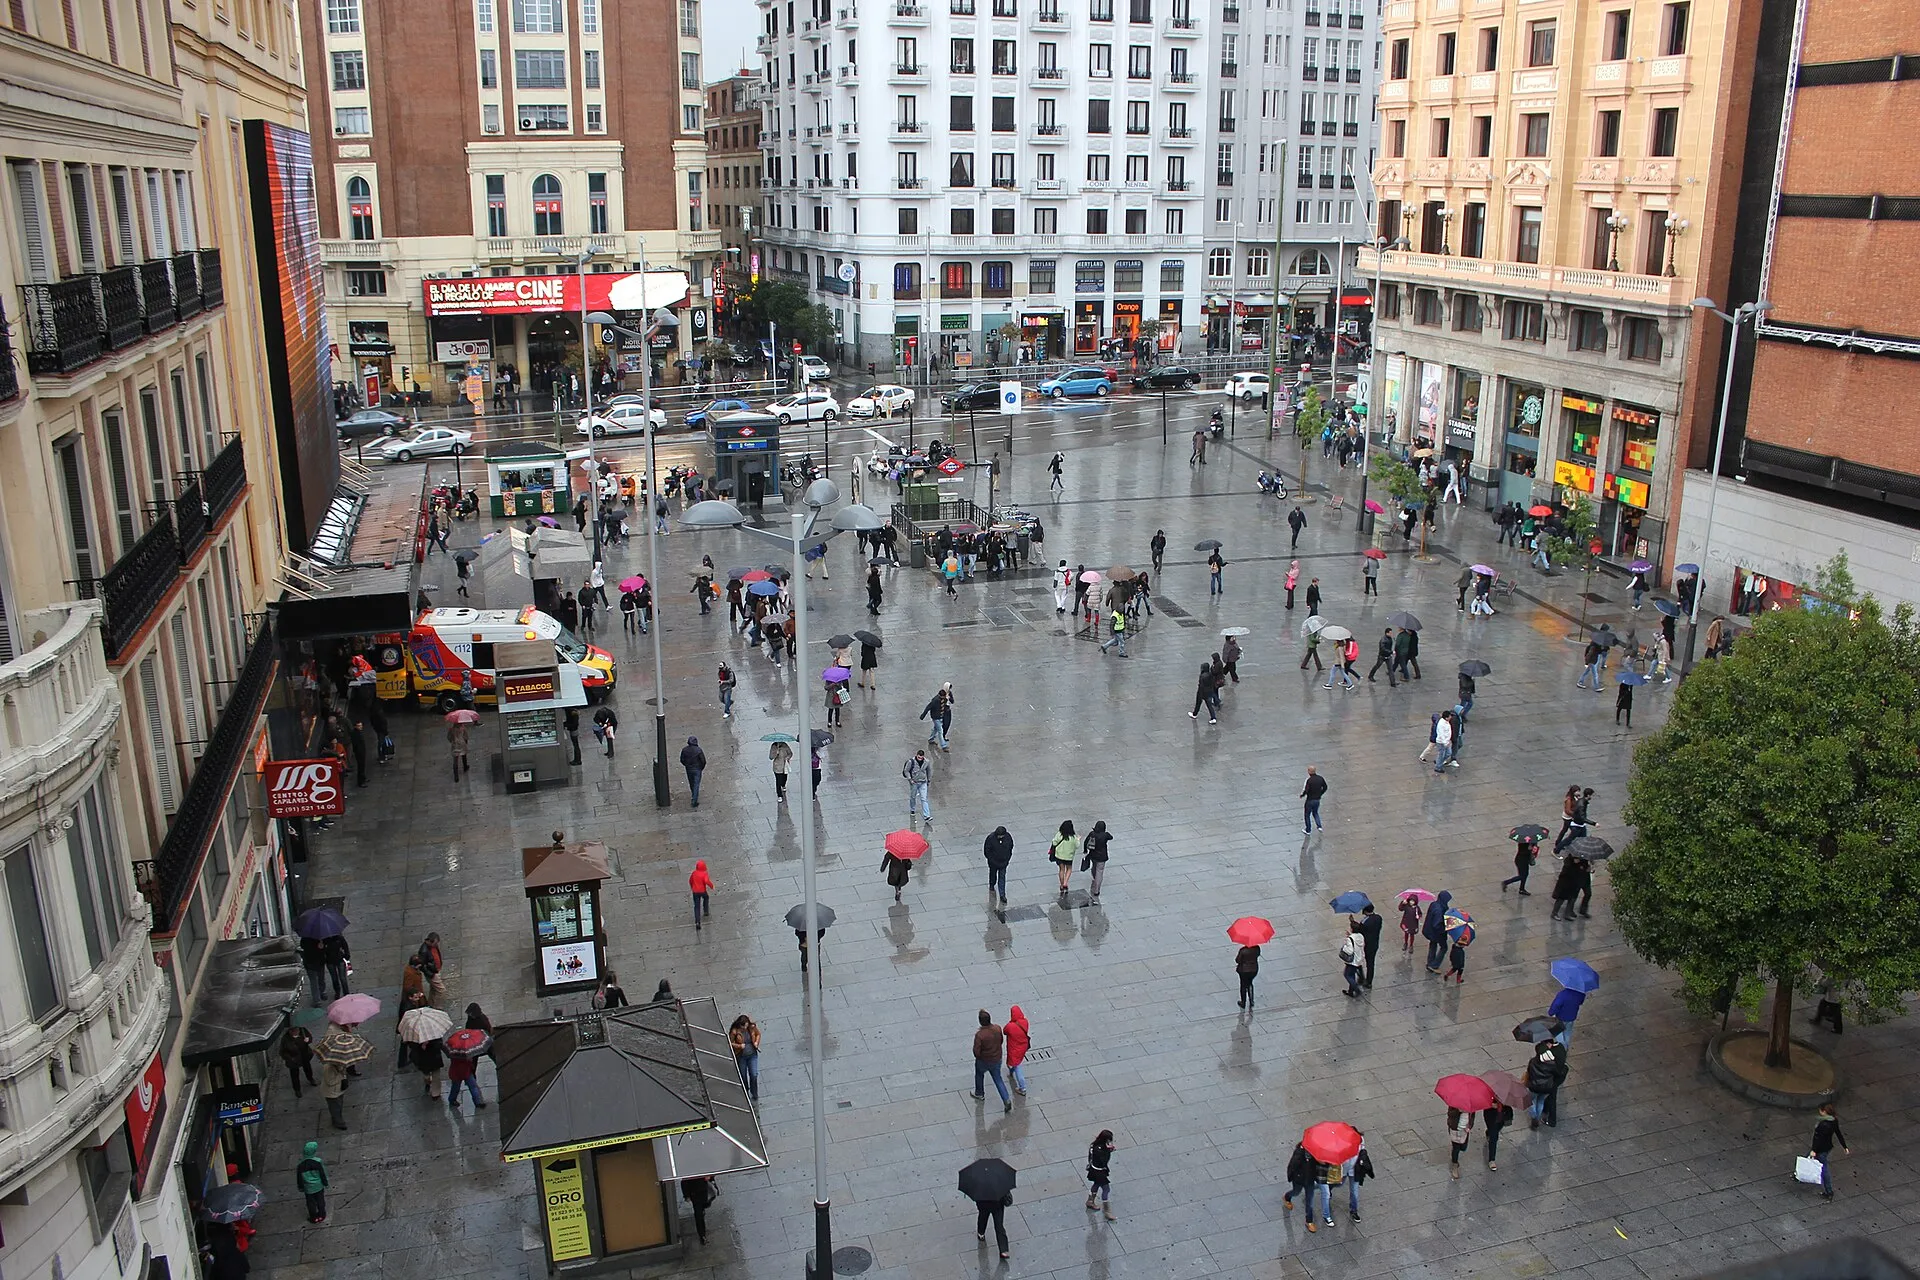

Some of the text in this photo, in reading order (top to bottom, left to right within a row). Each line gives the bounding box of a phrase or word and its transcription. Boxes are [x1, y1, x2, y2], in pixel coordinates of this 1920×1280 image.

[430, 285, 439, 293] EL
[441, 283, 457, 293] DÍA
[458, 284, 470, 292] DE
[484, 282, 514, 291] MADRE
[515, 279, 563, 299] CINE
[430, 291, 494, 302] UN REGALO DE
[1116, 303, 1139, 311] Orange
[1453, 428, 1473, 438] COFFEE
[515, 683, 552, 692] TABACOS
[548, 884, 579, 894] ONCE
[554, 967, 588, 977] JUNTOS
[220, 1098, 259, 1111] Banesto
[534, 1148, 555, 1156] COMPRO
[617, 1135, 635, 1143] PLANTA
[548, 1191, 582, 1206] ORO
